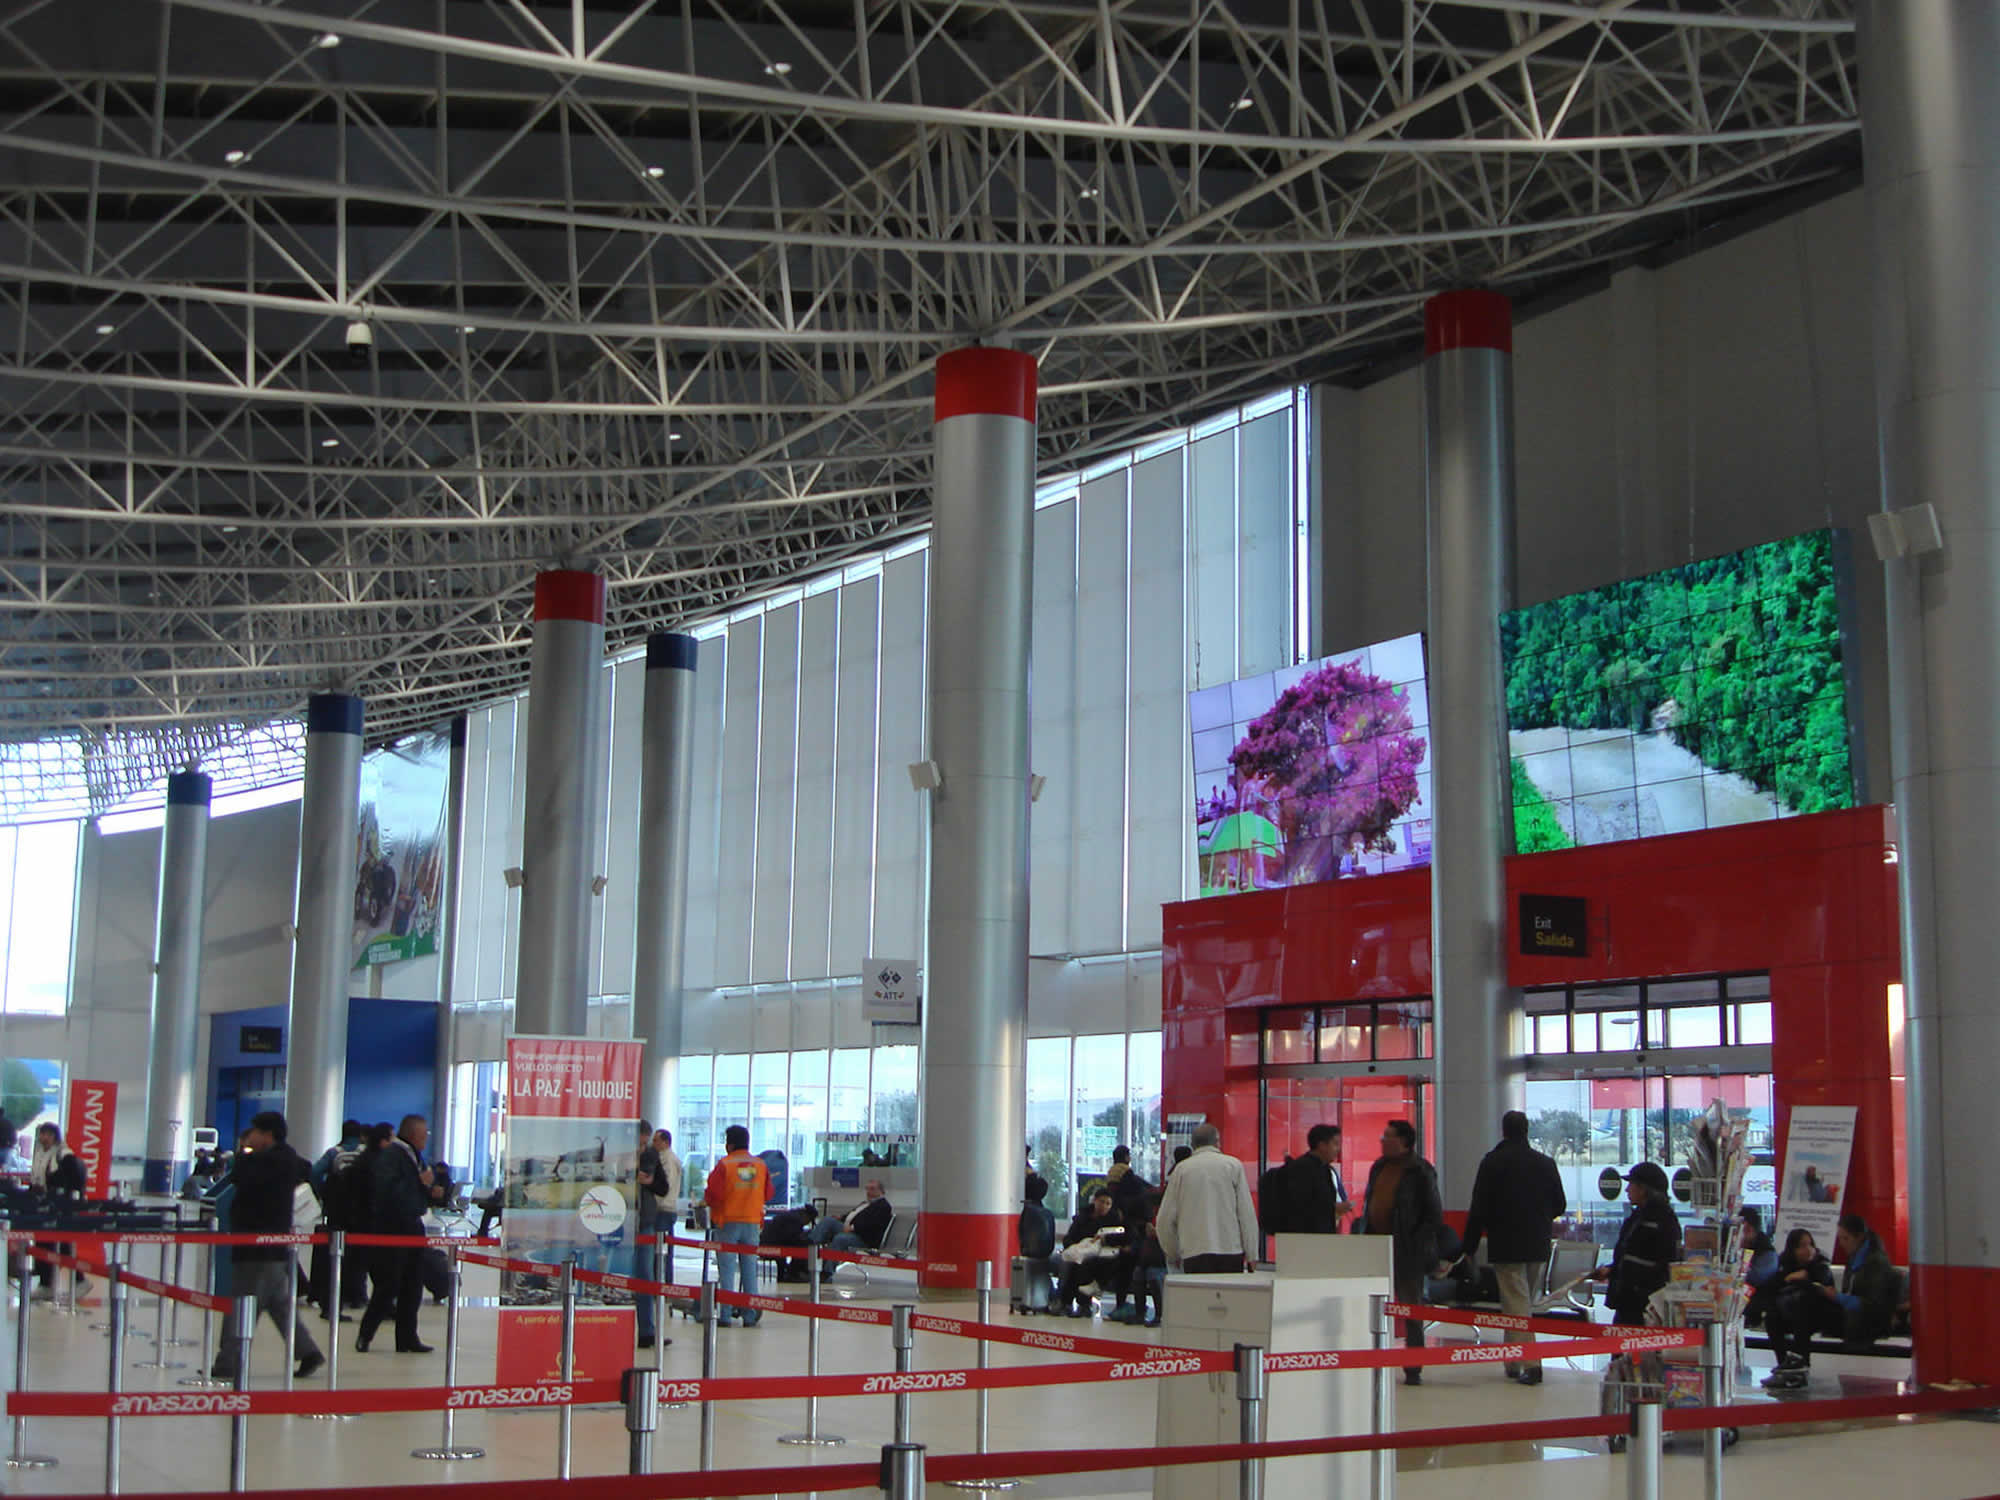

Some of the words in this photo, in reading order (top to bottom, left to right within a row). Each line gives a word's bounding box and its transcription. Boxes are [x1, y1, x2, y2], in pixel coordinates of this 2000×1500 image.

[1535, 914, 1552, 929] Exit
[1535, 930, 1575, 948] Salida
[513, 1078, 532, 1097] LA
[535, 1079, 561, 1098] PAZ
[578, 1080, 633, 1100] IQUIQUE
[844, 1134, 860, 1142] ATT
[868, 1133, 888, 1143] ATT
[897, 1134, 917, 1143] ATT
[255, 1234, 311, 1244] amaszonas
[427, 1237, 479, 1246] amaszonas
[838, 1308, 879, 1323] amaszonas
[1473, 1313, 1529, 1331] amaszonas
[915, 1315, 962, 1335] amaszonas
[1021, 1330, 1075, 1351] amaszonas
[1620, 1332, 1685, 1350] amaszonas
[1450, 1345, 1524, 1362] amaszonas
[1110, 1356, 1201, 1379] amaszonas
[863, 1371, 967, 1393] amaszonas
[111, 1394, 251, 1414] amaszonas
[447, 1384, 573, 1407] amaszonas
